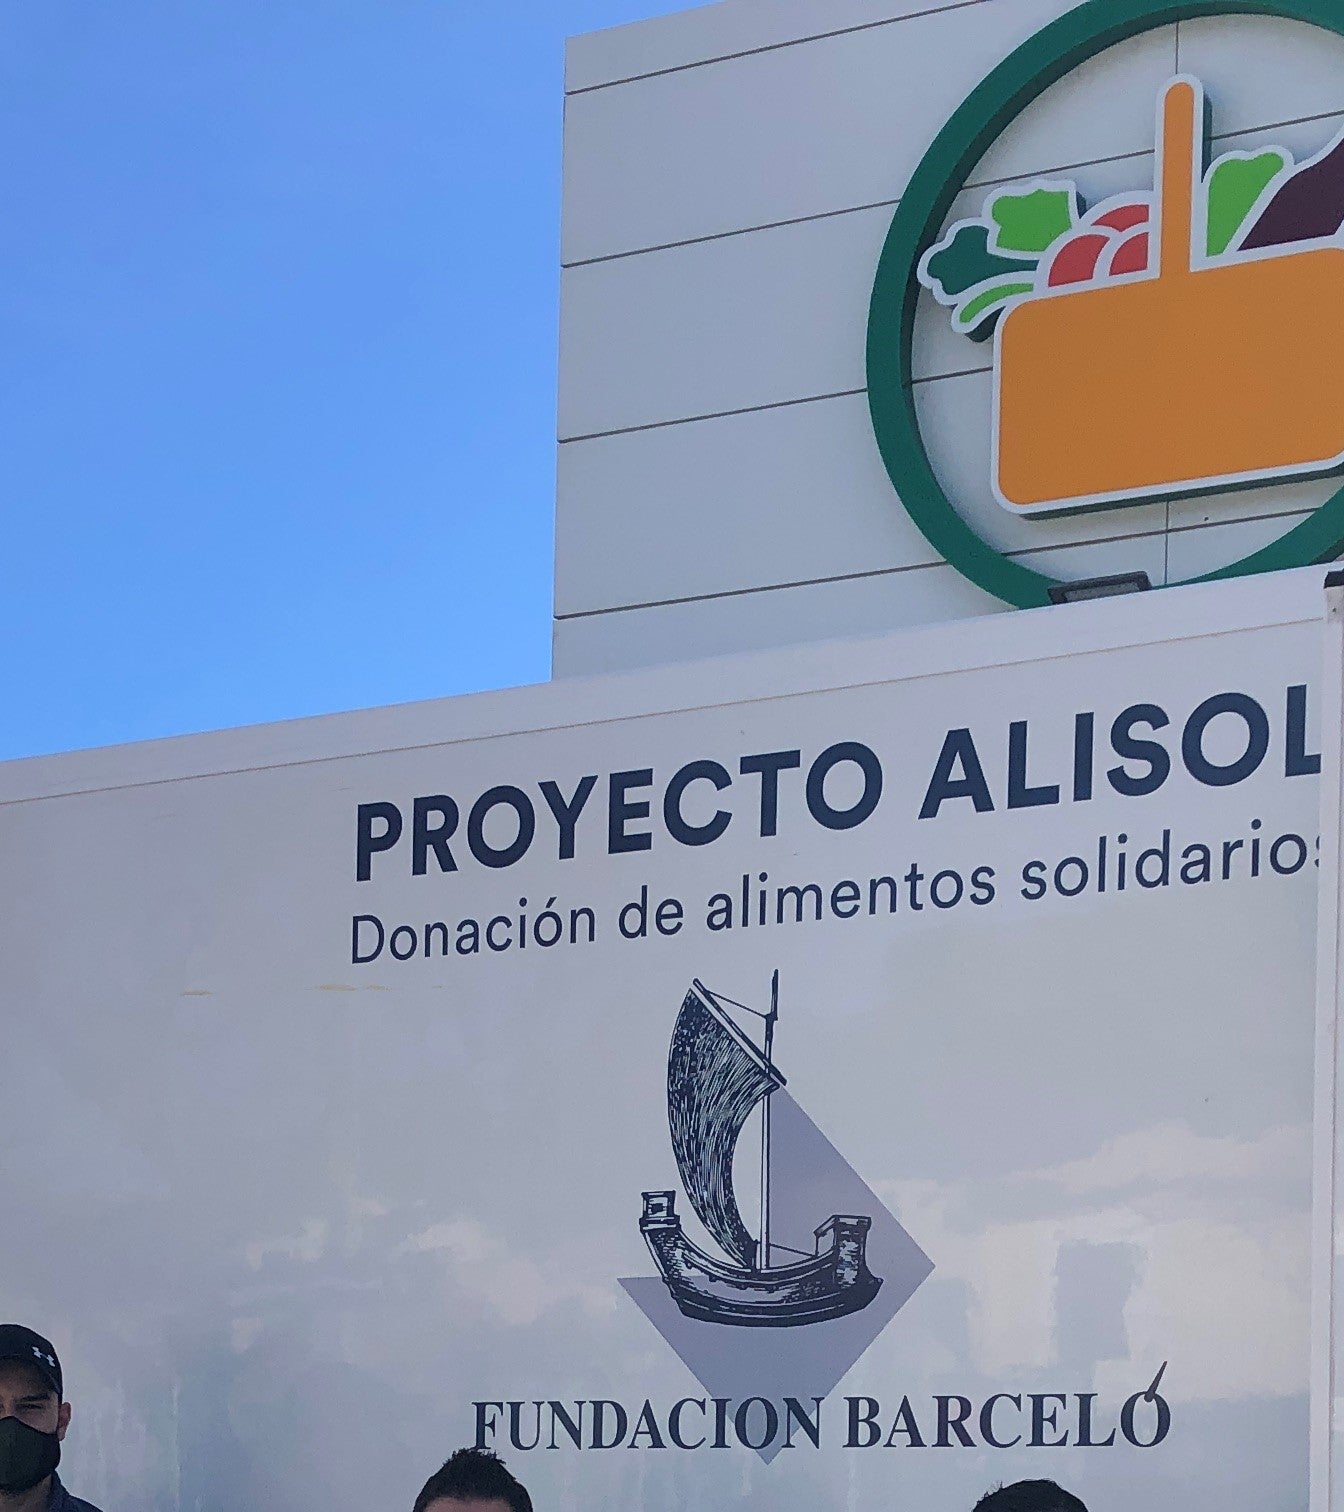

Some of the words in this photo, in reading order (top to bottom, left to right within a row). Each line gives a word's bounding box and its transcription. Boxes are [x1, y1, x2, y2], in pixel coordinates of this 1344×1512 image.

[356, 741, 884, 882] PROYECTO
[918, 684, 1322, 820] ALISOL
[351, 897, 596, 965] Donación
[618, 885, 685, 939] de
[705, 863, 996, 932] alimentos
[470, 1395, 826, 1453] FUNDACION
[842, 1361, 1171, 1449] BARCELÓ
